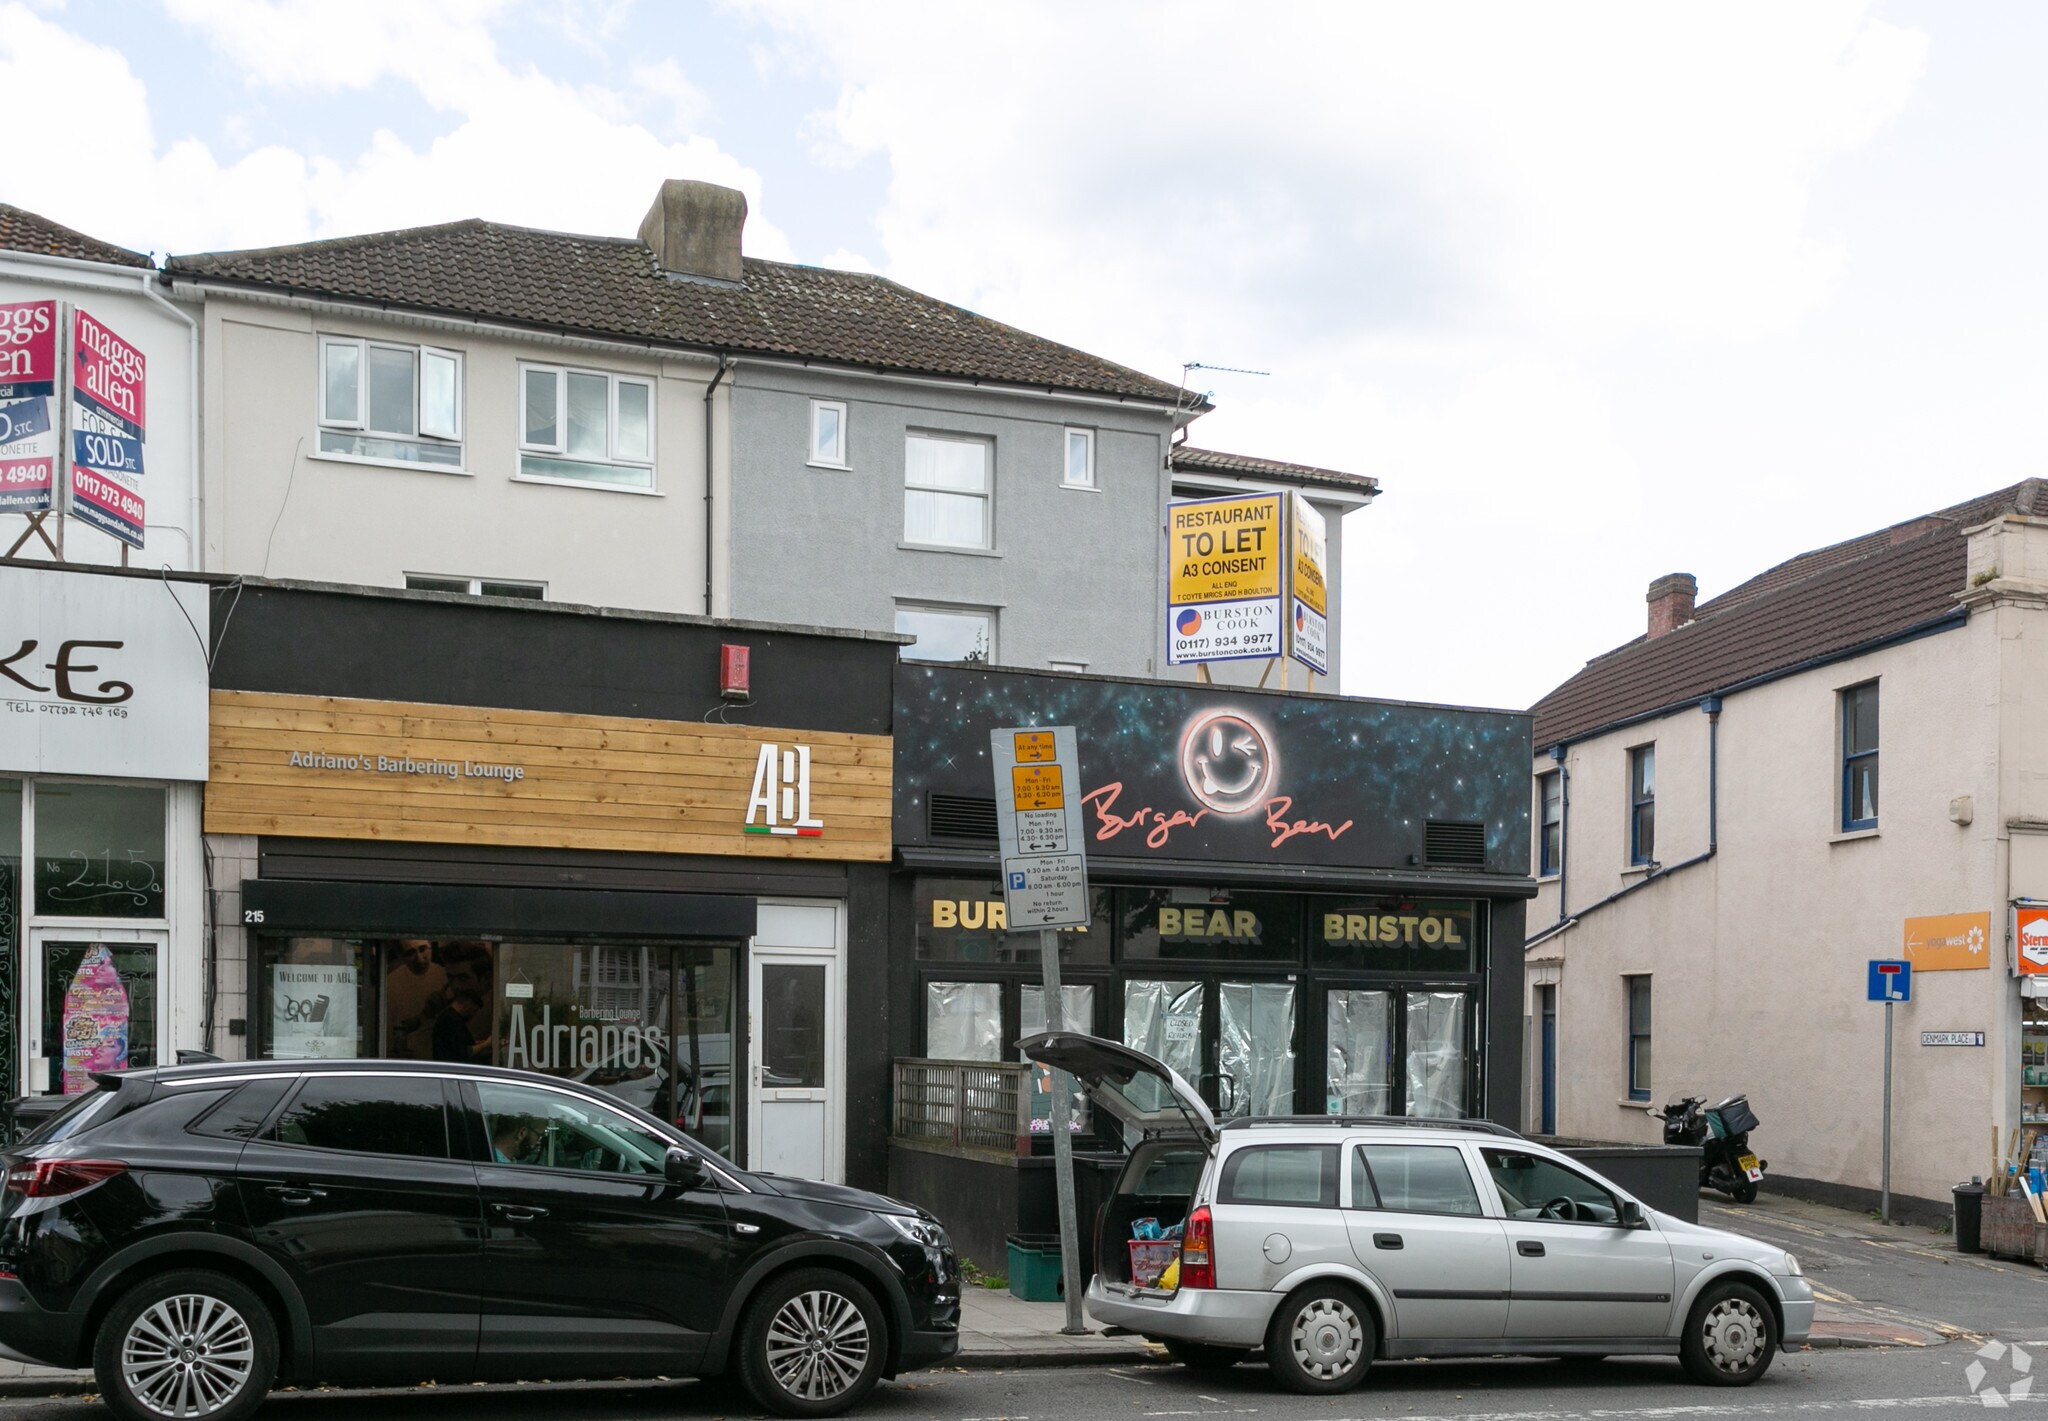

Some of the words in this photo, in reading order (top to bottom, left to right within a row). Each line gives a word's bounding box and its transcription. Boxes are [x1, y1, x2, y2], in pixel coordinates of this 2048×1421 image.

[81, 318, 144, 385] maggs
[87, 360, 136, 416] allen
[14, 420, 34, 437] STC
[85, 434, 125, 467] SOLD
[125, 457, 137, 470] STC
[6, 464, 47, 483] 4940
[75, 471, 101, 497] 0117
[101, 484, 120, 508] 973
[120, 495, 143, 520] 4940
[1176, 505, 1273, 528] RESTAURANT
[1182, 531, 1214, 557] TO
[1222, 527, 1267, 554] LET
[1182, 564, 1198, 578] A3
[1202, 557, 1266, 576] CONSENT
[1182, 592, 1202, 601] COYTE
[1203, 590, 1223, 598] MRICS
[1224, 588, 1237, 597] AND
[1244, 586, 1273, 595] BOULTON
[1212, 582, 1223, 590] ALL
[1204, 605, 1273, 620] BURSTON
[1217, 618, 1259, 630] COOK
[1176, 637, 1210, 651] (0117)
[1215, 636, 1237, 647] 934
[1243, 633, 1273, 645] 9977
[1176, 645, 1273, 659] www.burstoncook.co.uk
[6, 701, 35, 713] TEL
[80, 707, 103, 717] 746
[377, 755, 459, 779] Barbering
[464, 761, 524, 783] Lounge
[745, 743, 824, 828] ABL
[1081, 782, 1208, 848] Burger
[1012, 874, 1023, 889] P
[245, 910, 264, 922] 215
[1159, 908, 1257, 938] BEAR
[1324, 913, 1462, 944] BRISTOL
[279, 971, 318, 983] WELCOME
[323, 974, 333, 983] TO
[579, 1005, 614, 1022] Barbering
[615, 1005, 641, 1022] Lounge
[1922, 1033, 1949, 1044] DENMARK
[1951, 1033, 1969, 1044] PLACE
